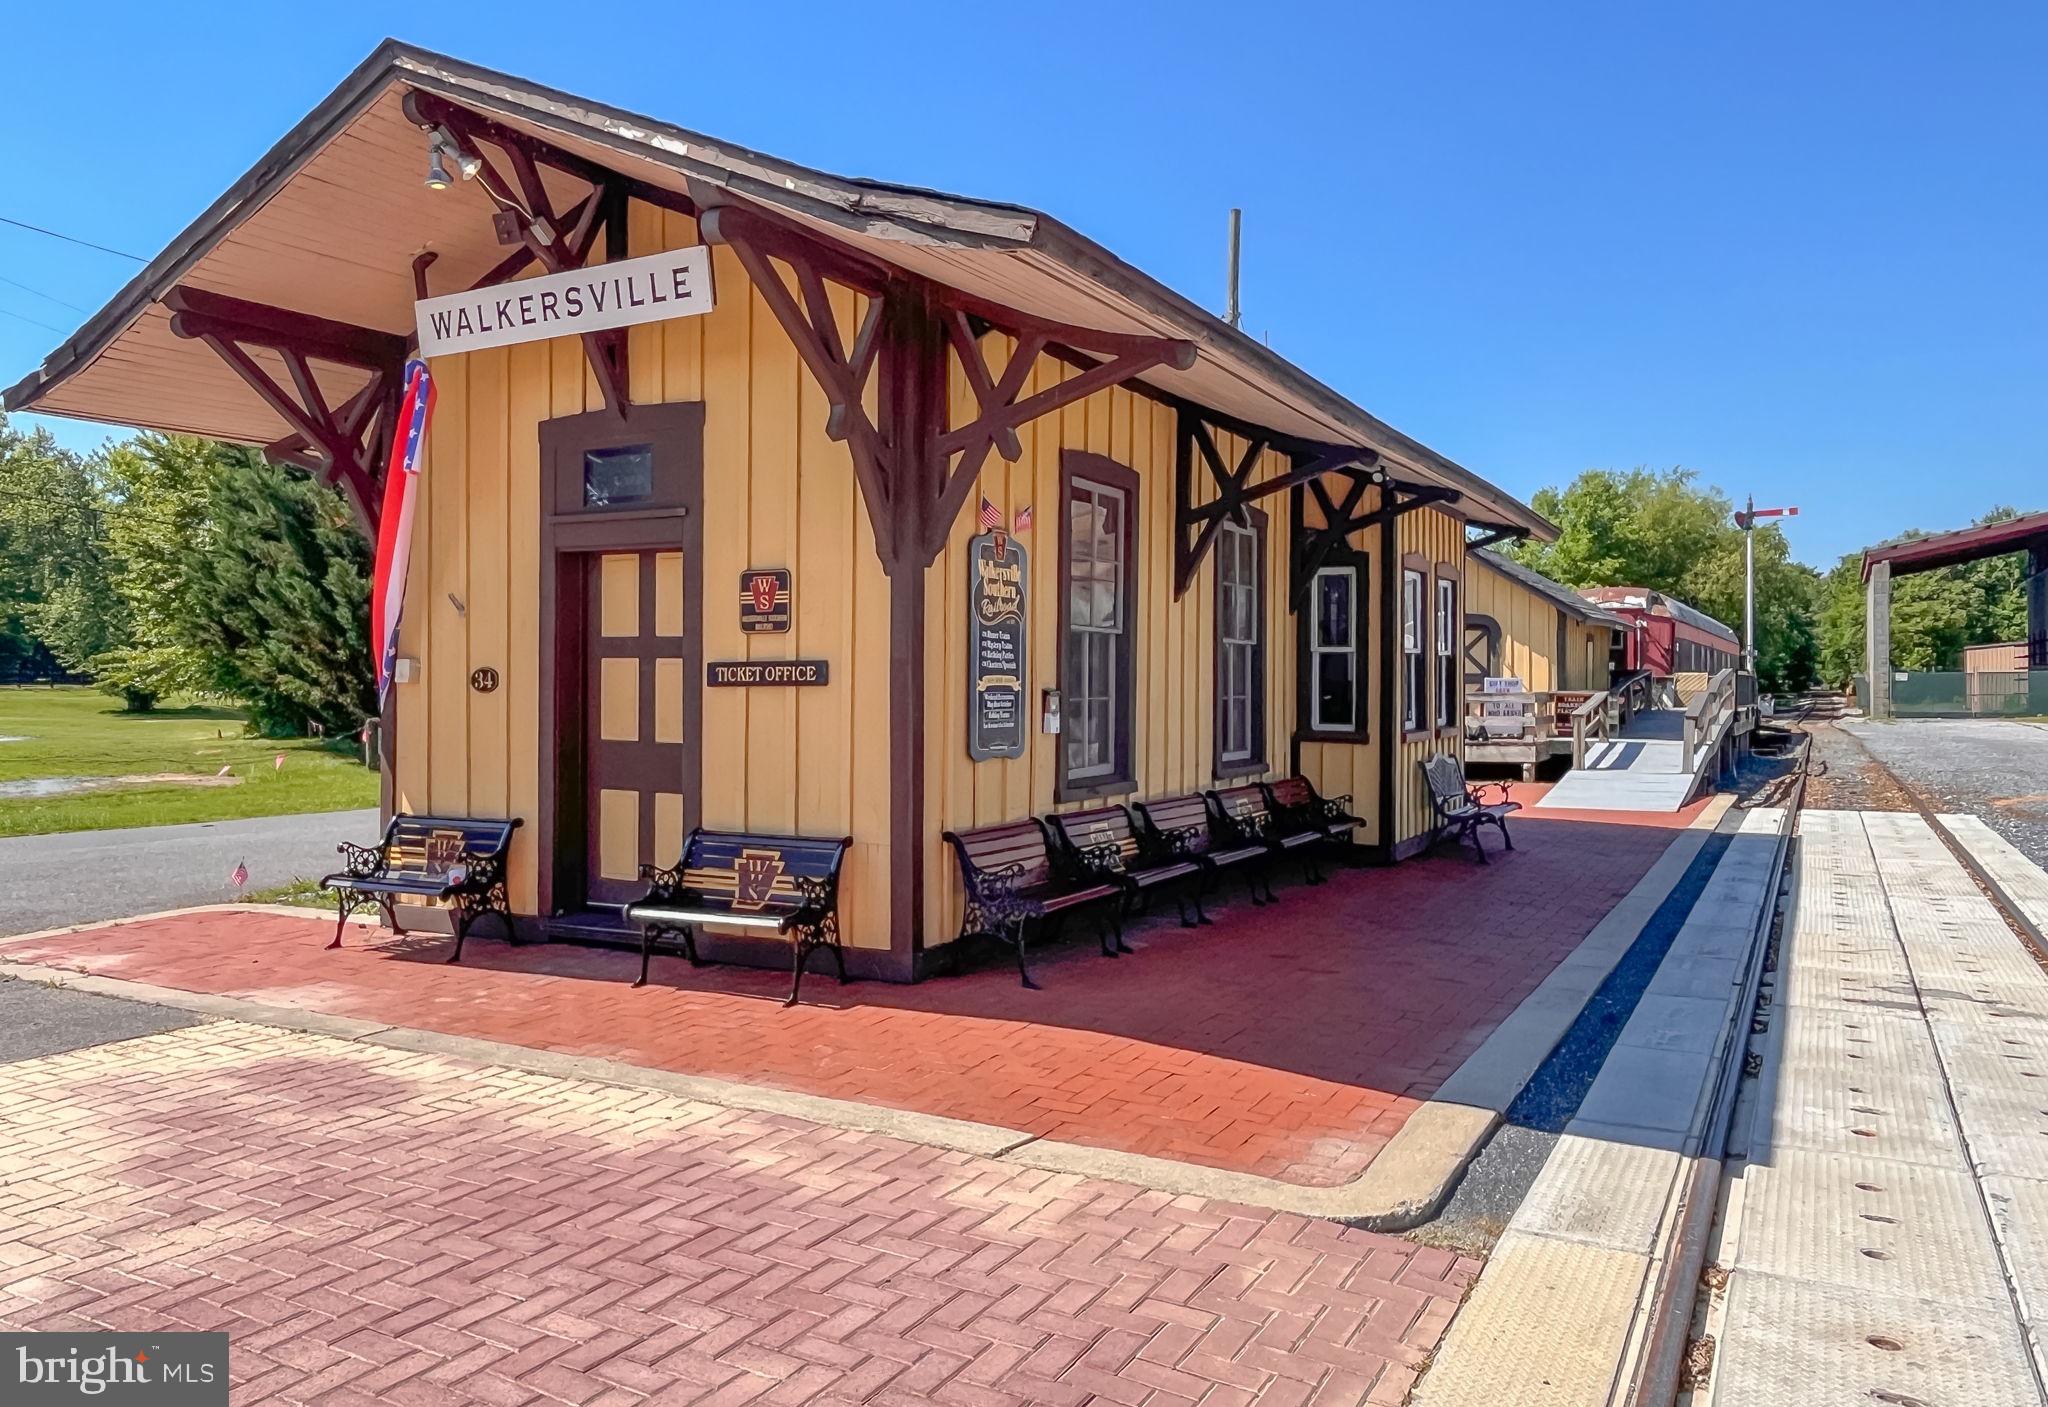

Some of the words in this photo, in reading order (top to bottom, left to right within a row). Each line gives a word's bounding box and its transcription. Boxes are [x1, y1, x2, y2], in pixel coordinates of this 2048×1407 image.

[430, 265, 692, 340] WALKERSVILLE
[757, 579, 772, 593] W
[760, 595, 770, 609] S
[475, 671, 493, 689] 34
[716, 666, 763, 682] TICKET
[765, 666, 817, 681] OFFICE
